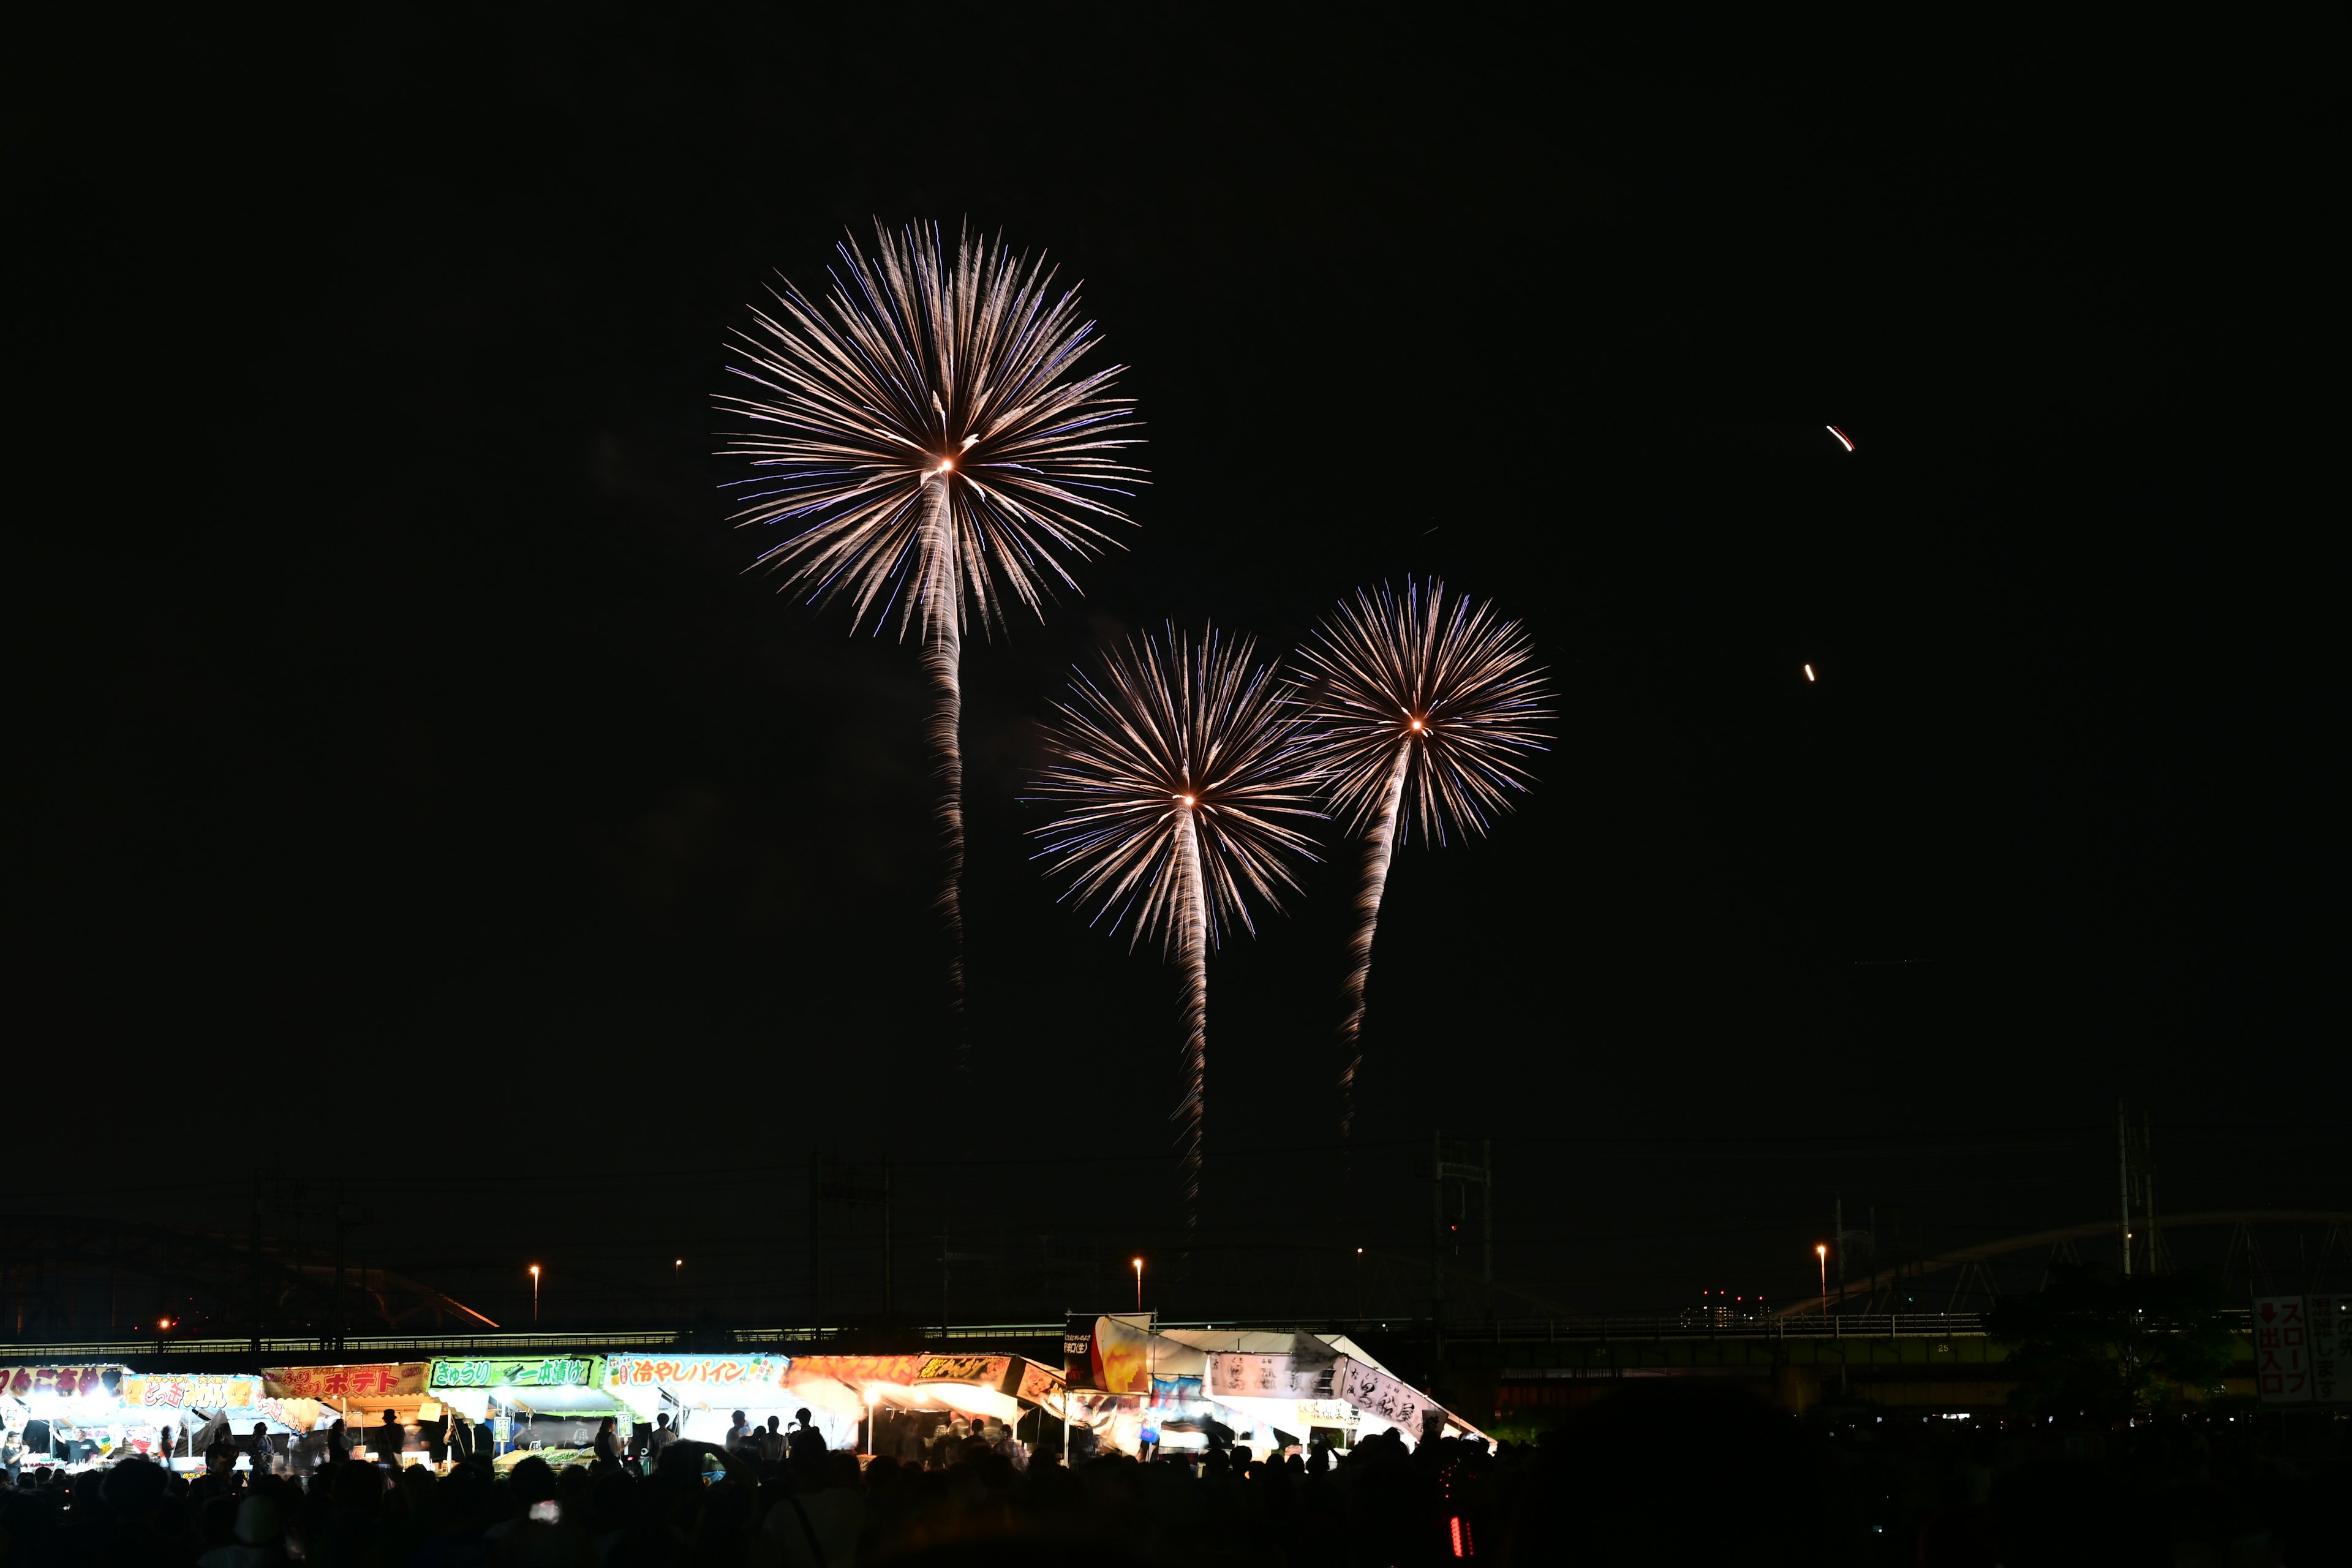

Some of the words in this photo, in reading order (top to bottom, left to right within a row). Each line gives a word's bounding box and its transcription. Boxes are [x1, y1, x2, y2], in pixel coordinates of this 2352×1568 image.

[2258, 1327, 2283, 1394] 出入口
[2282, 1303, 2307, 1393] スロープ
[2312, 1298, 2335, 1398] 混雑します
[322, 1371, 399, 1395] ポテト
[435, 1361, 491, 1385] きゅうり
[518, 1360, 584, 1385] 一本漬け
[632, 1360, 745, 1383] 冷やしパイン
